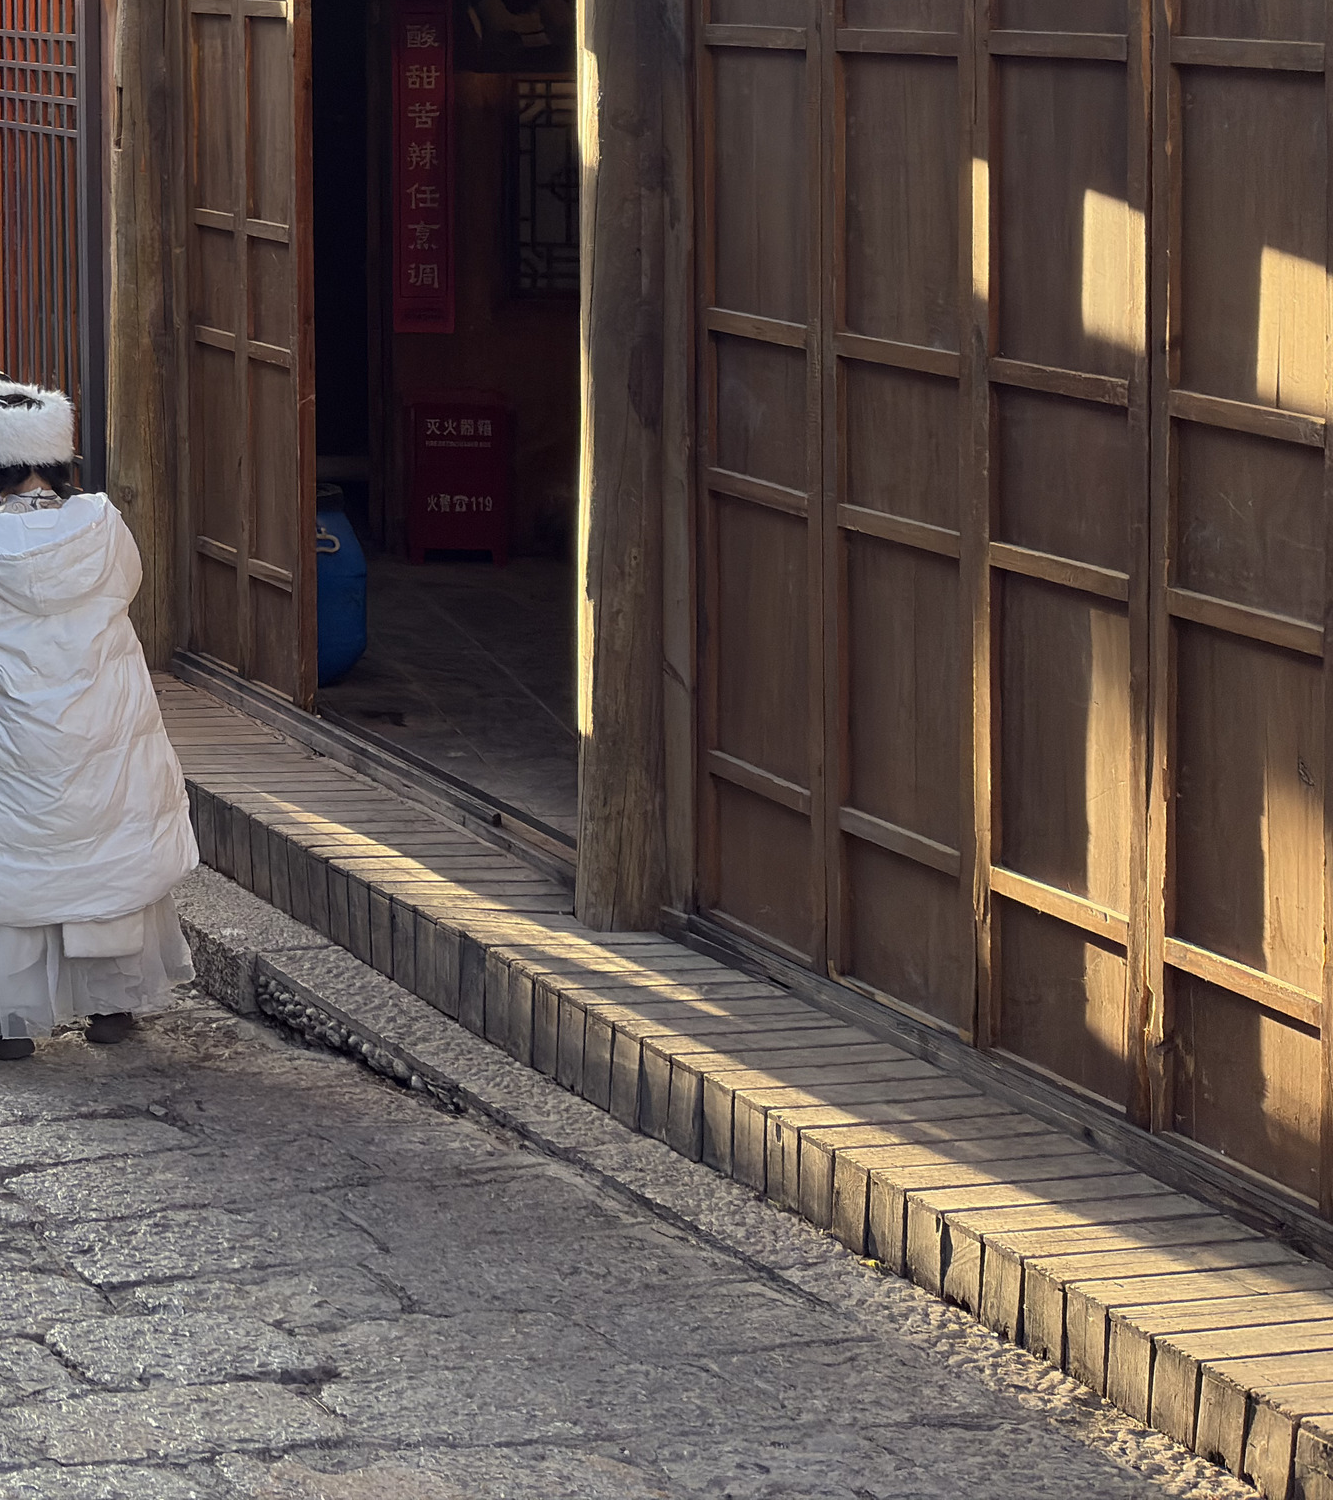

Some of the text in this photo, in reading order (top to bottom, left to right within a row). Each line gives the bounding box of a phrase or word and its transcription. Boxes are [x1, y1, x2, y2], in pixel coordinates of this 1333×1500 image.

[405, 24, 440, 288] 酸甜苦辣任烹调
[425, 419, 493, 436] 灭火器箱
[471, 496, 493, 512] 119
